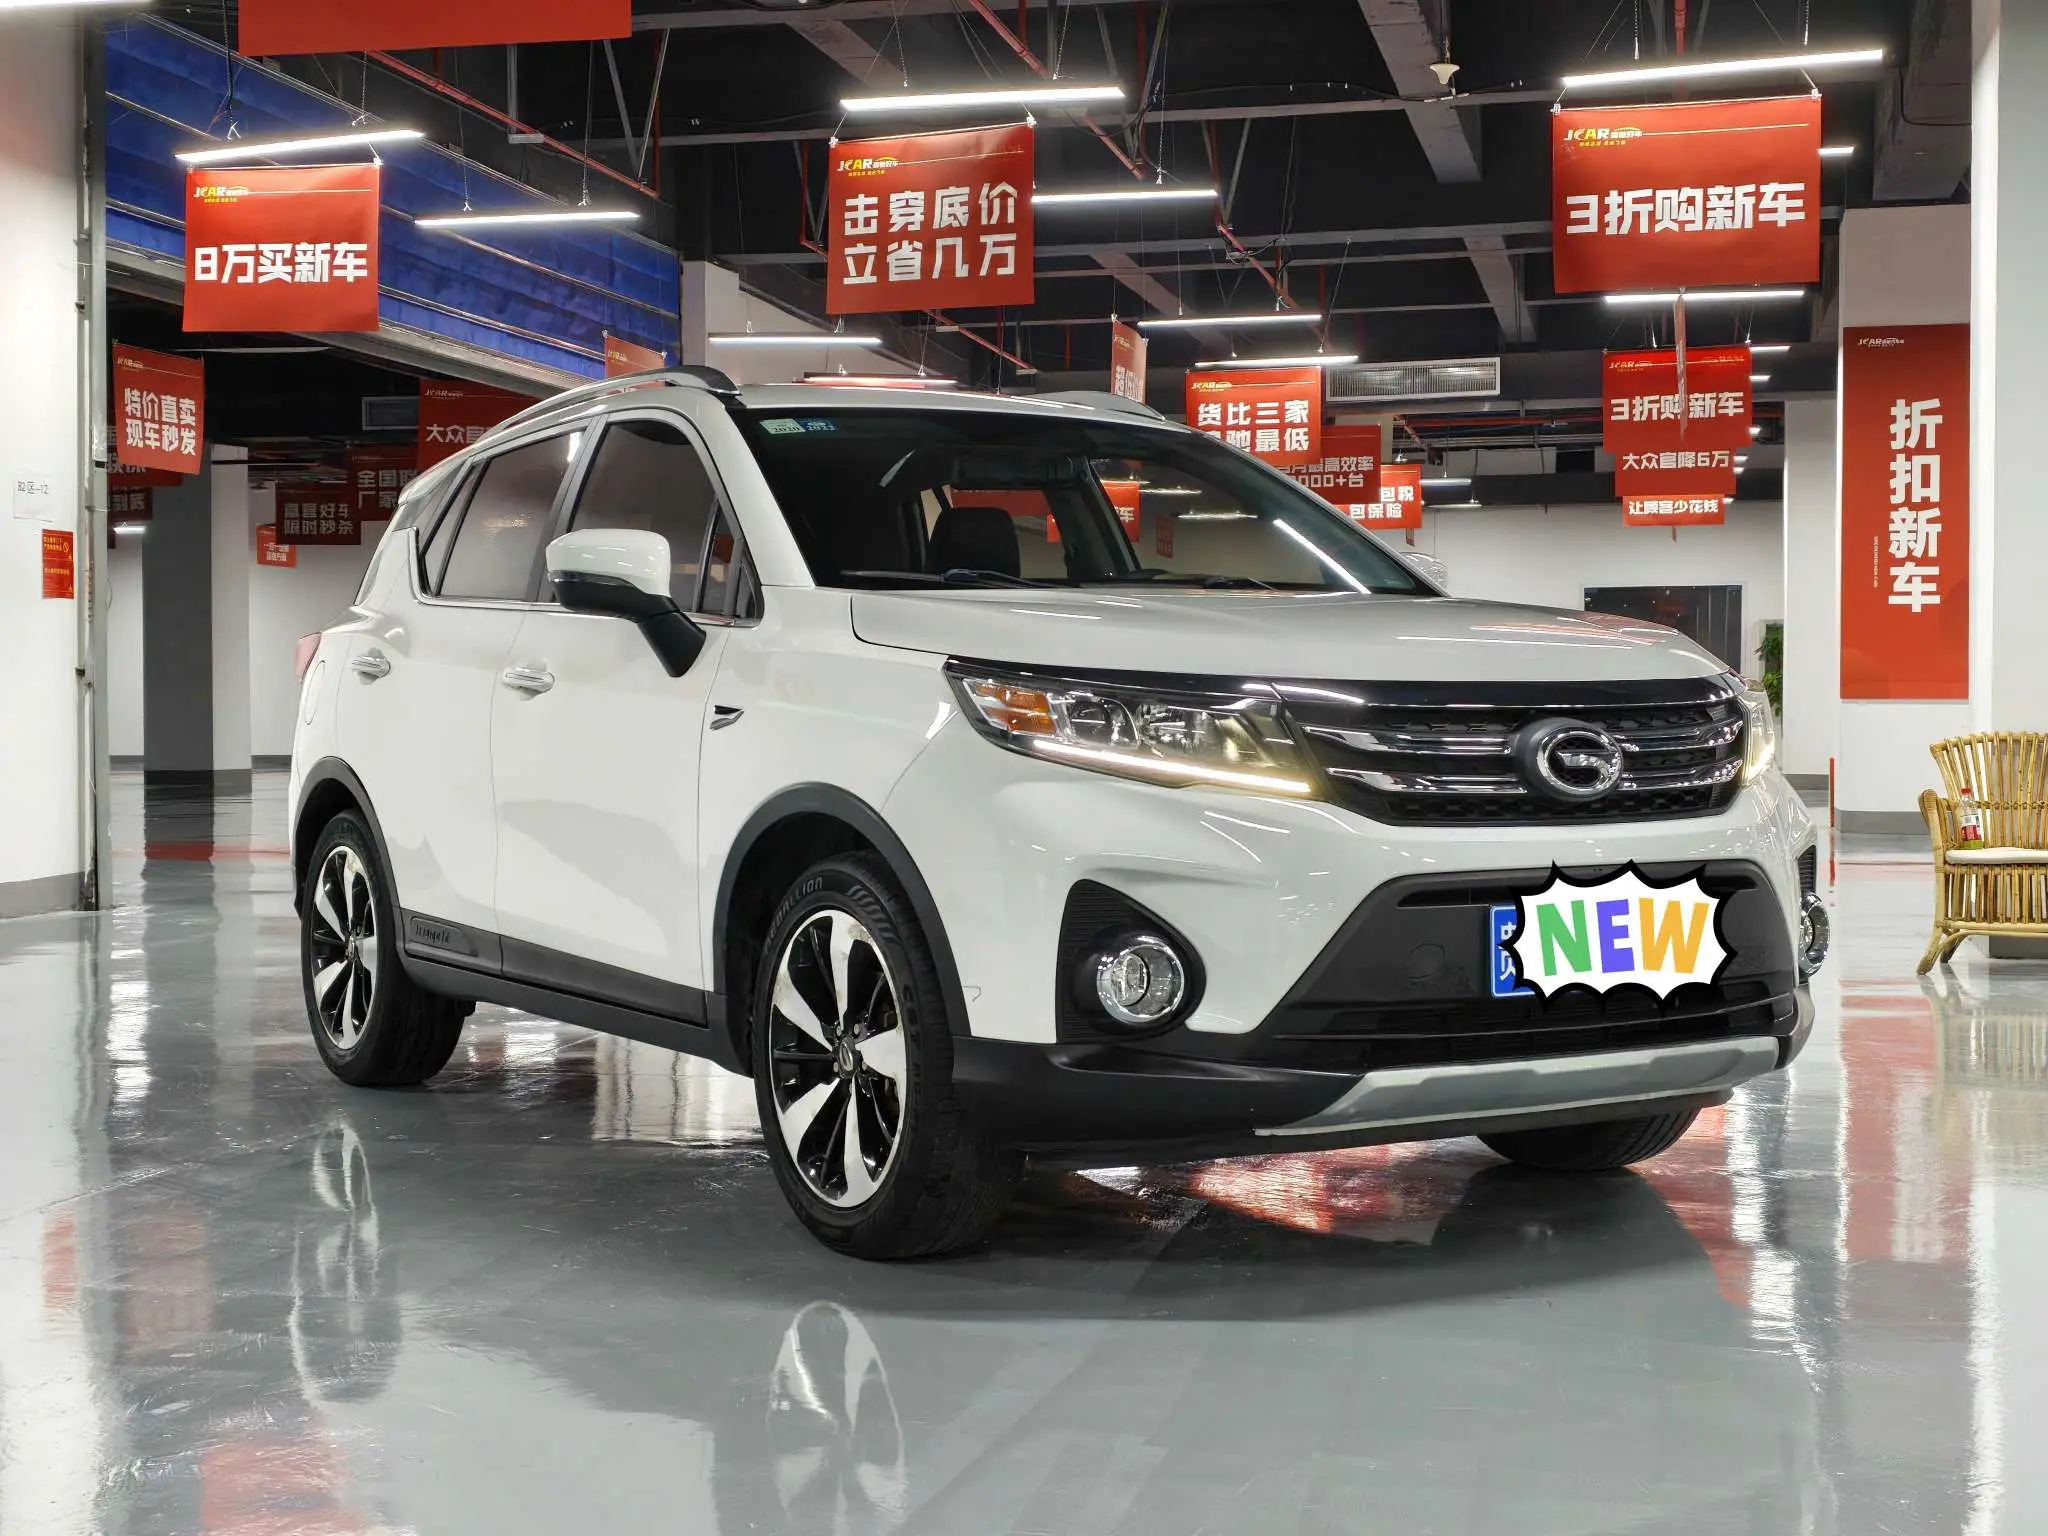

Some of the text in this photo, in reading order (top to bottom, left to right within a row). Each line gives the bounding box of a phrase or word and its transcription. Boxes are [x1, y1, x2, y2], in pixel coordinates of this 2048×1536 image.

[1564, 128, 1610, 141] JCAR
[844, 181, 1016, 236] 击穿底价
[1566, 182, 1805, 235] 3折购新车
[194, 242, 368, 284] 8万买新车
[843, 233, 1016, 285] 立省几万
[124, 387, 196, 427] 特价直卖
[1197, 399, 1310, 427] 货比三家
[1610, 391, 1745, 422] 3折购新车
[126, 418, 196, 456] 现车秒发
[426, 424, 489, 444] 大众官
[1622, 451, 1730, 470] 大众官降6万
[1288, 473, 1364, 488] 000+台
[1888, 399, 1943, 613] 折扣新车
